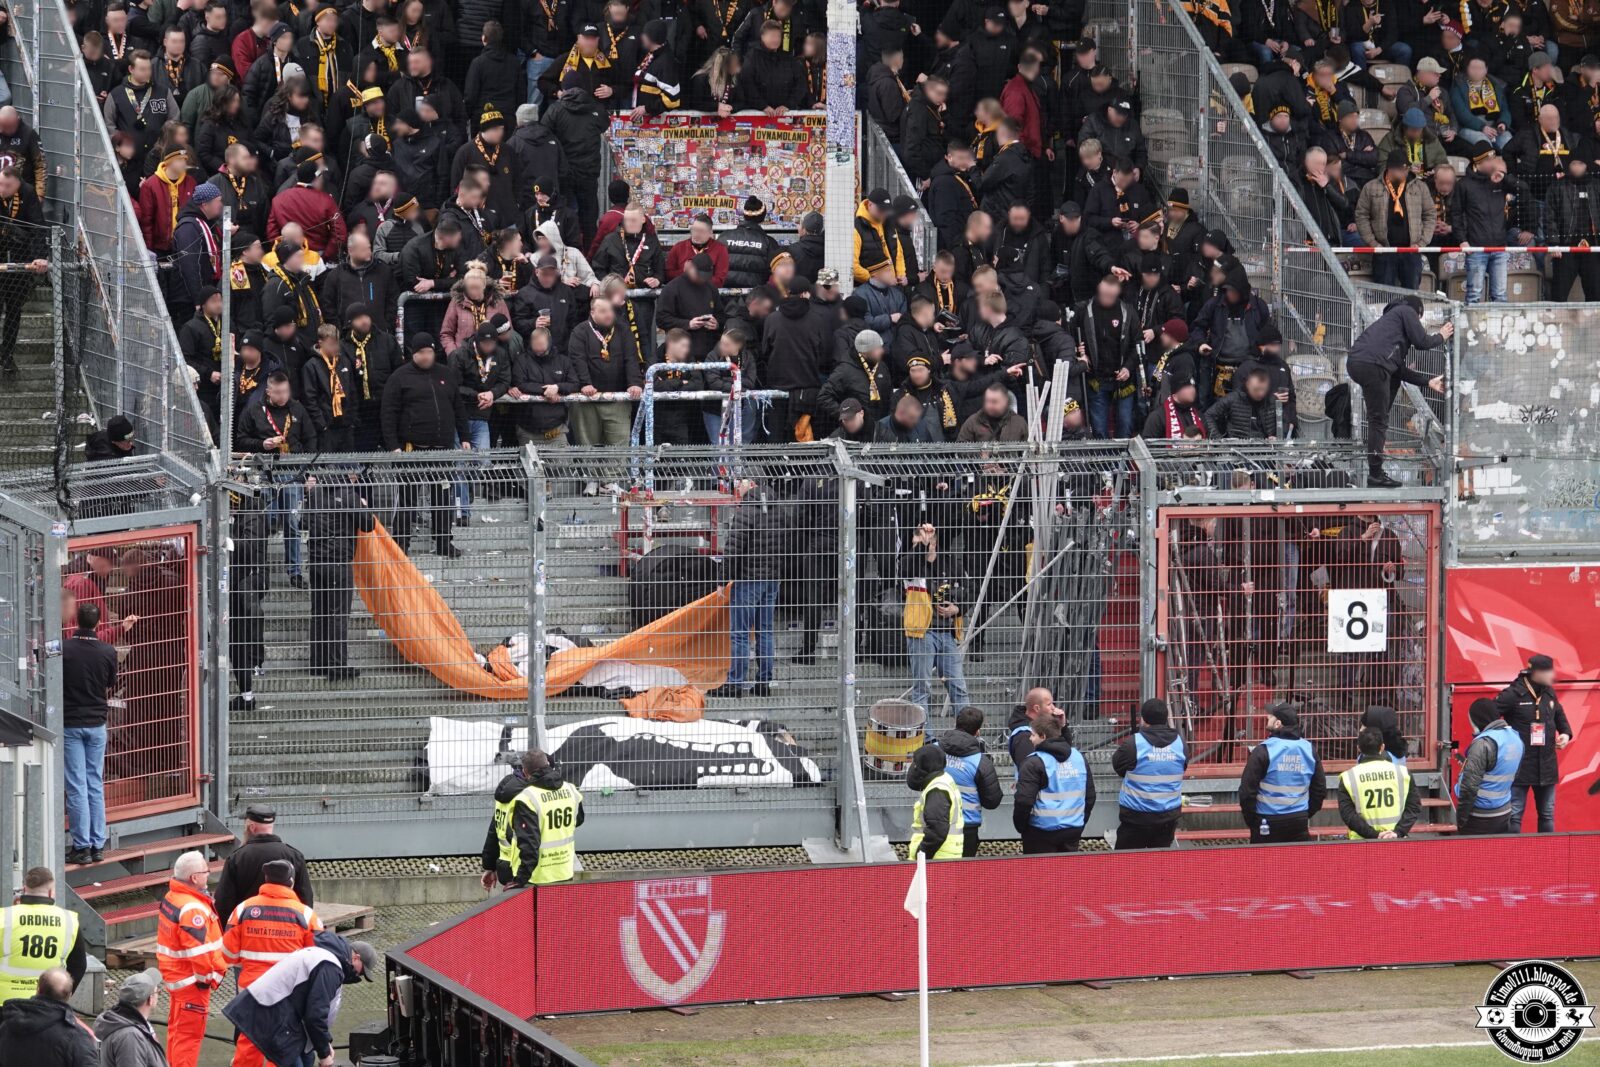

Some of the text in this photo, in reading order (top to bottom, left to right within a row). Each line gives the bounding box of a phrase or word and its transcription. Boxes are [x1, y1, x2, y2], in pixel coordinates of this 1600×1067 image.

[663, 129, 715, 139] DYNAMOLAND
[756, 131, 808, 142] DYNAMOLAND
[683, 197, 734, 208] DYNAMOLAND
[1346, 601, 1369, 640] 8
[1282, 754, 1301, 763] IHRE
[1277, 762, 1305, 772] WACHE
[1359, 771, 1395, 783] ORDNER
[540, 788, 572, 803] ORDNER
[1364, 787, 1394, 809] 276
[546, 806, 573, 830] 166
[19, 914, 61, 927] ORDNER
[19, 934, 58, 959] 186
